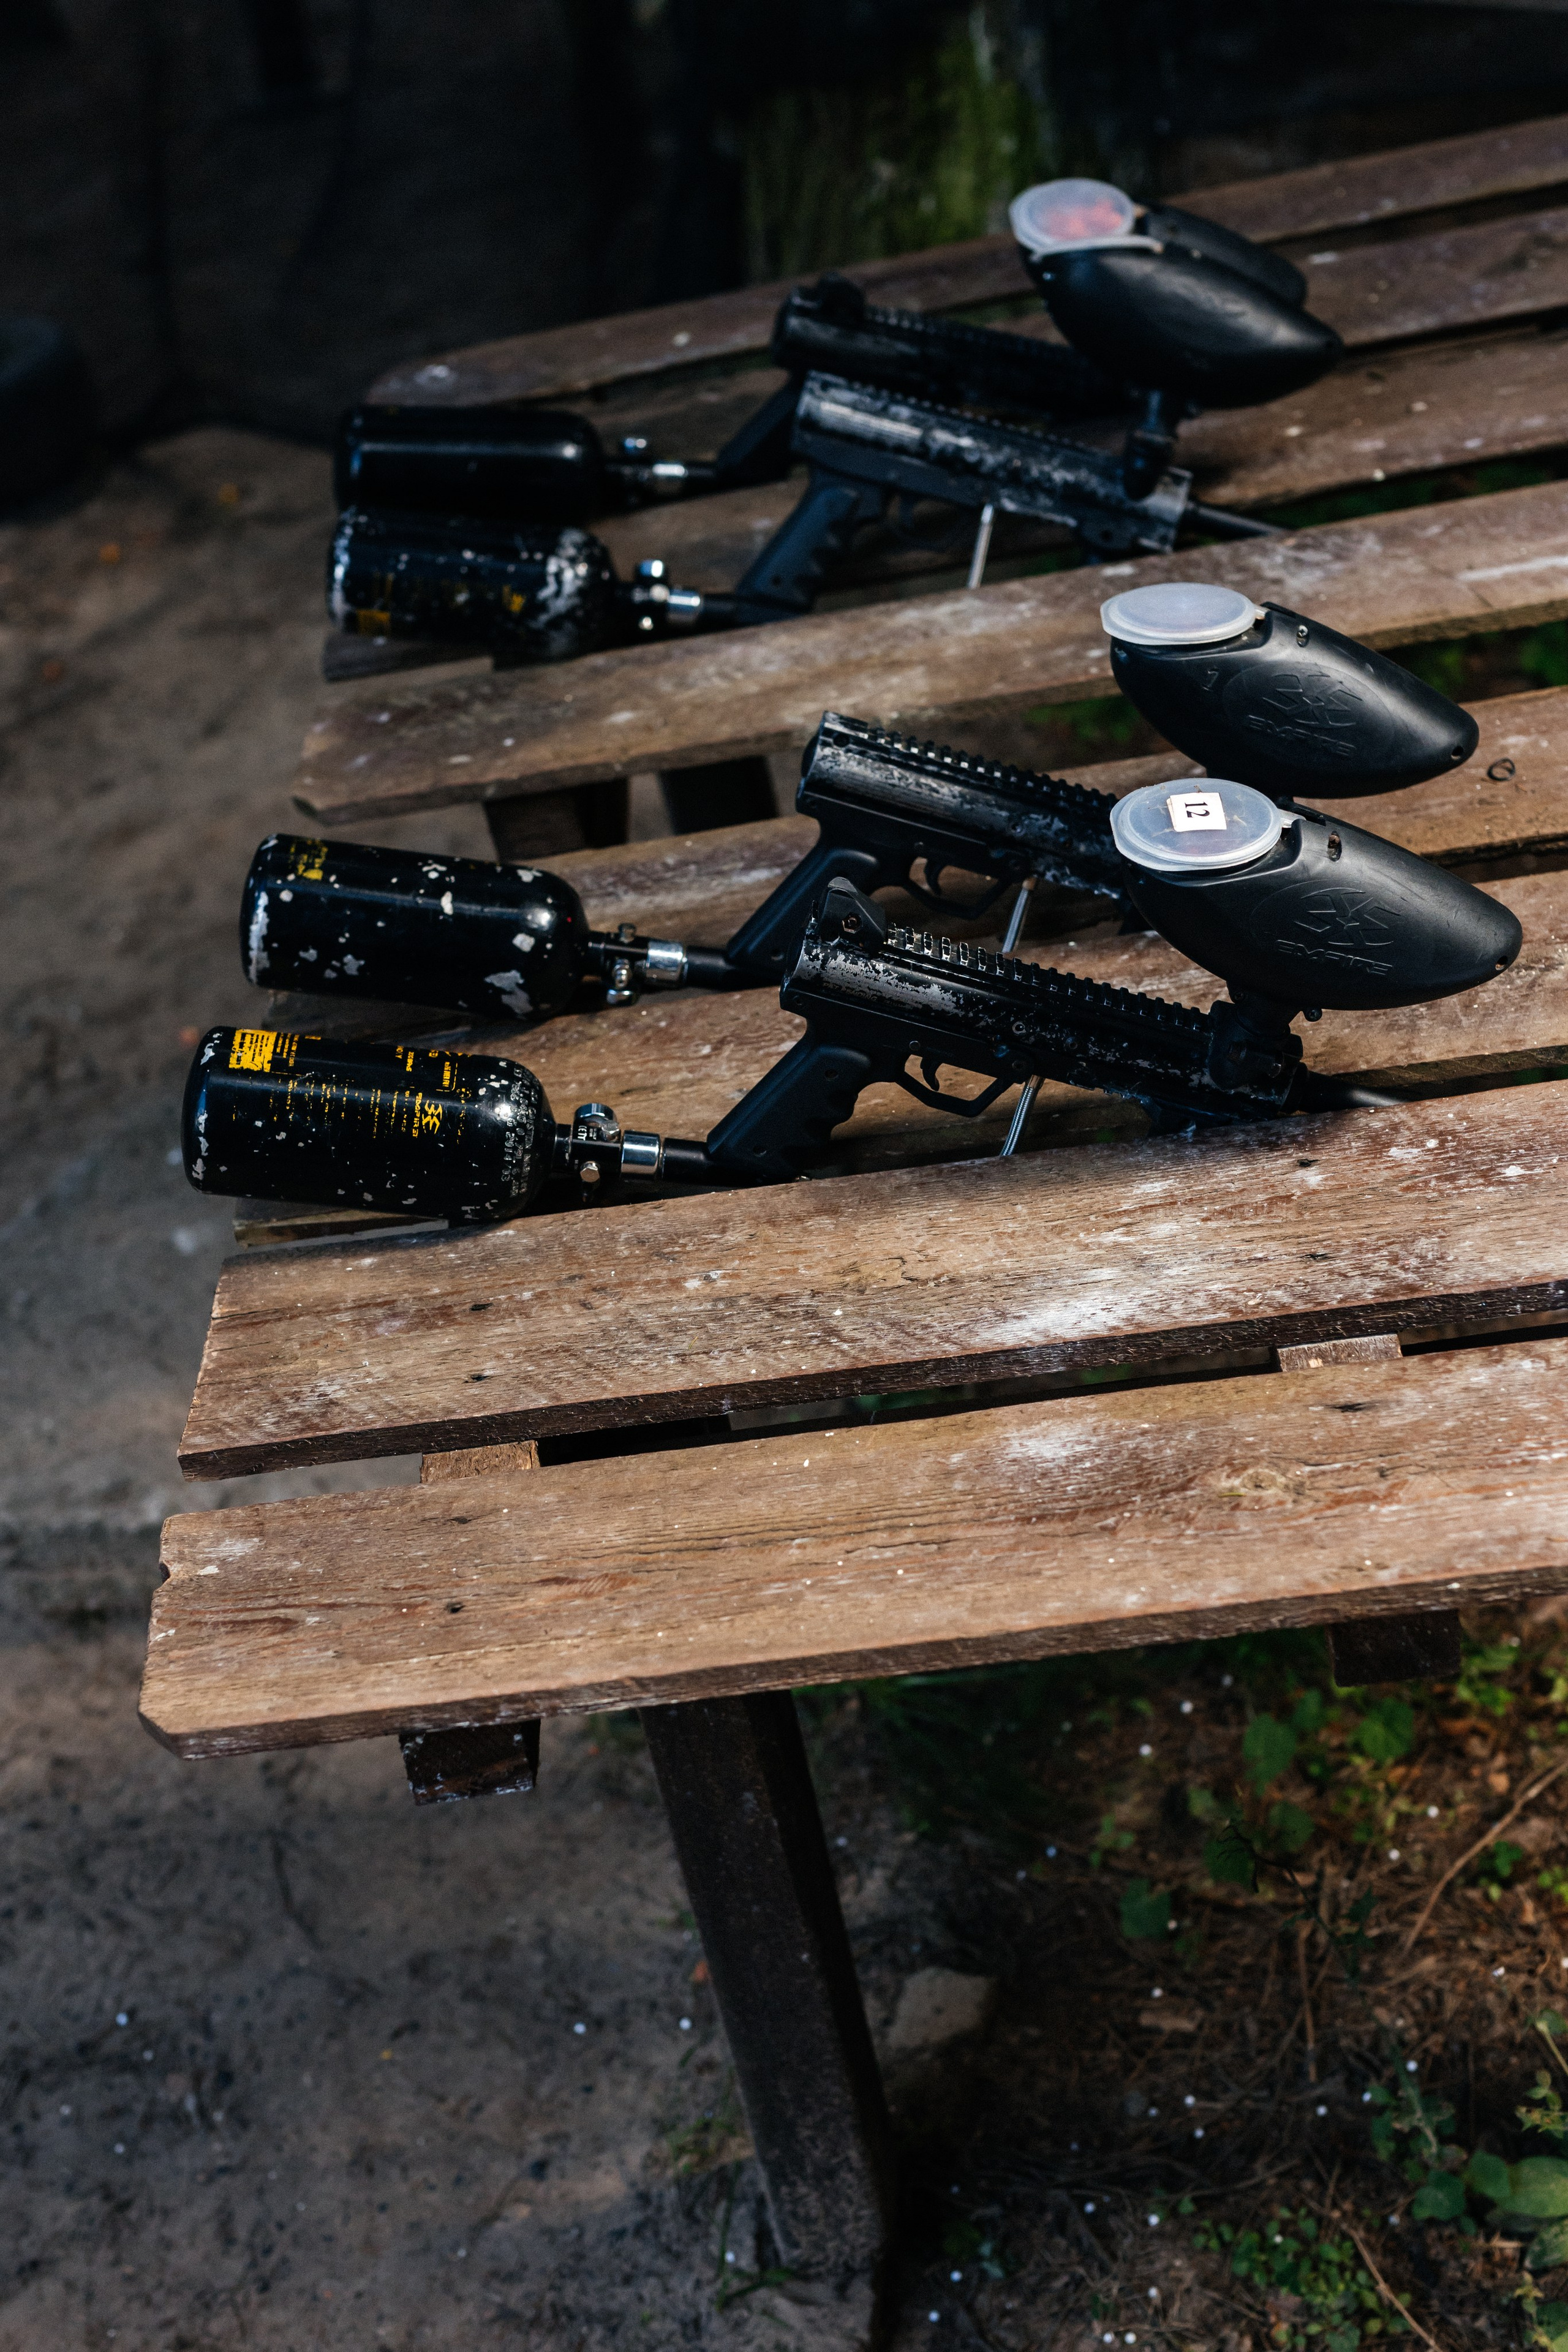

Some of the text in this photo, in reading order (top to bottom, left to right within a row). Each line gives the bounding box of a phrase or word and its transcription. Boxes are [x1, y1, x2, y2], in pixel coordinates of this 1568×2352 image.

[1247, 714, 1357, 757] EMPIRE
[1184, 801, 1210, 818] 12
[1276, 939, 1393, 976] EMPIRE
[412, 1092, 423, 1139] EMPIRE
